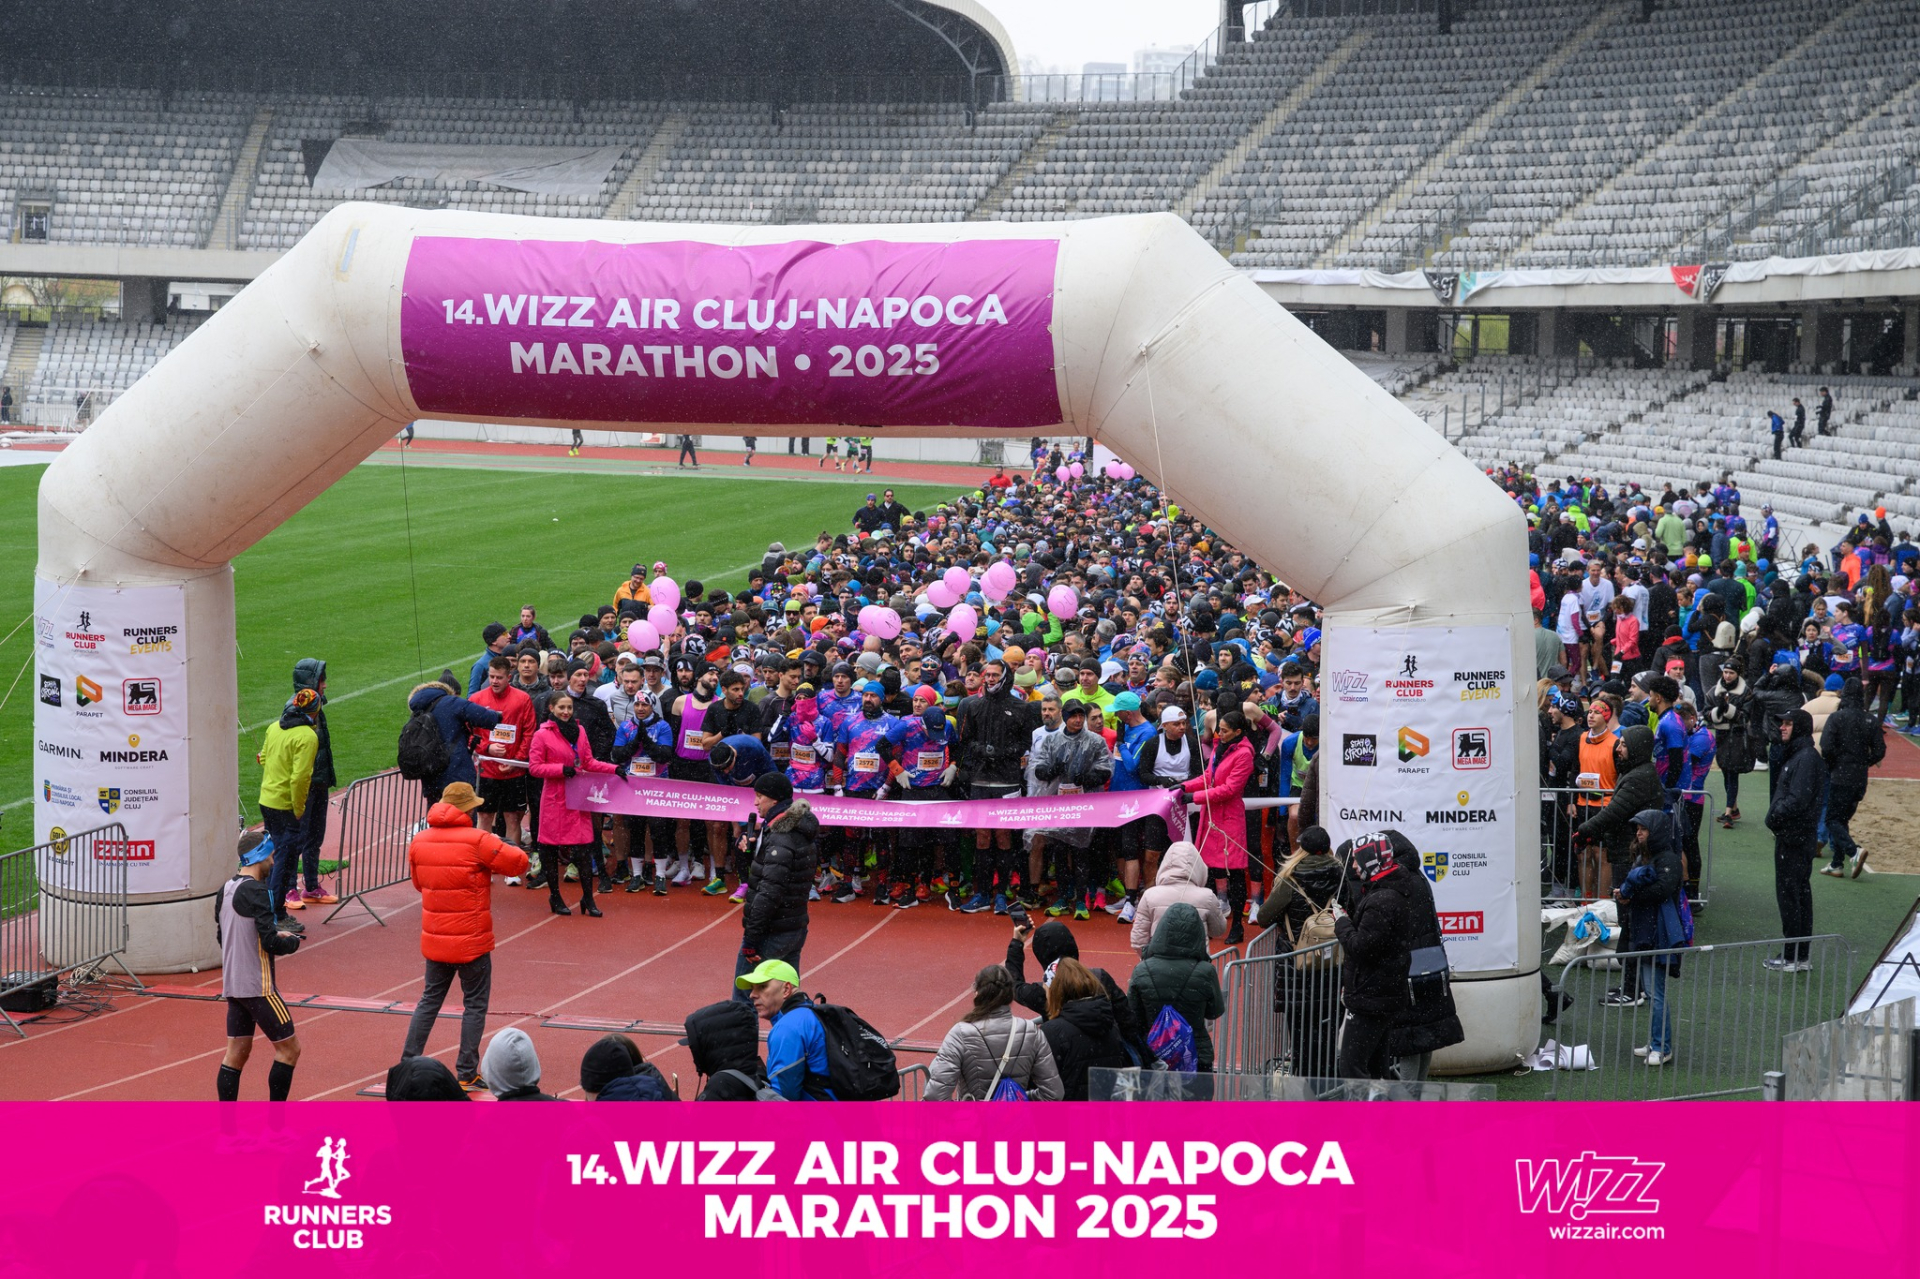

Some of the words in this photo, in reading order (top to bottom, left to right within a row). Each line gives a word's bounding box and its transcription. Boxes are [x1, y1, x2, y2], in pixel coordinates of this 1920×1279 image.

[607, 298, 680, 329] AIR
[693, 294, 1008, 330] CLUJ-NAPOCA
[510, 342, 778, 378] MARATHON
[828, 343, 939, 377] 2025
[124, 626, 178, 636] RUNNERS
[66, 632, 106, 642] RUNNERS
[136, 636, 166, 645] CLUB
[74, 641, 96, 649] CLUB
[130, 641, 172, 654] EVENTS
[1454, 671, 1506, 681] RUNNERS
[1386, 680, 1434, 688] RUNNERS
[1467, 681, 1496, 690] CLUB
[1396, 689, 1424, 697] CLUB
[1460, 688, 1500, 702] EVENTS
[1350, 738, 1364, 748] STAY
[100, 750, 168, 762] MINDERA
[1344, 744, 1374, 761] STRONG
[646, 798, 696, 809] MARATHON
[682, 794, 740, 804] CLUJ-NAPOCA
[1036, 804, 1094, 814] CLUJ-NAPOCA
[822, 814, 874, 822] MARATHON
[1426, 809, 1497, 824] MINDERA
[1438, 916, 1479, 930] izin
